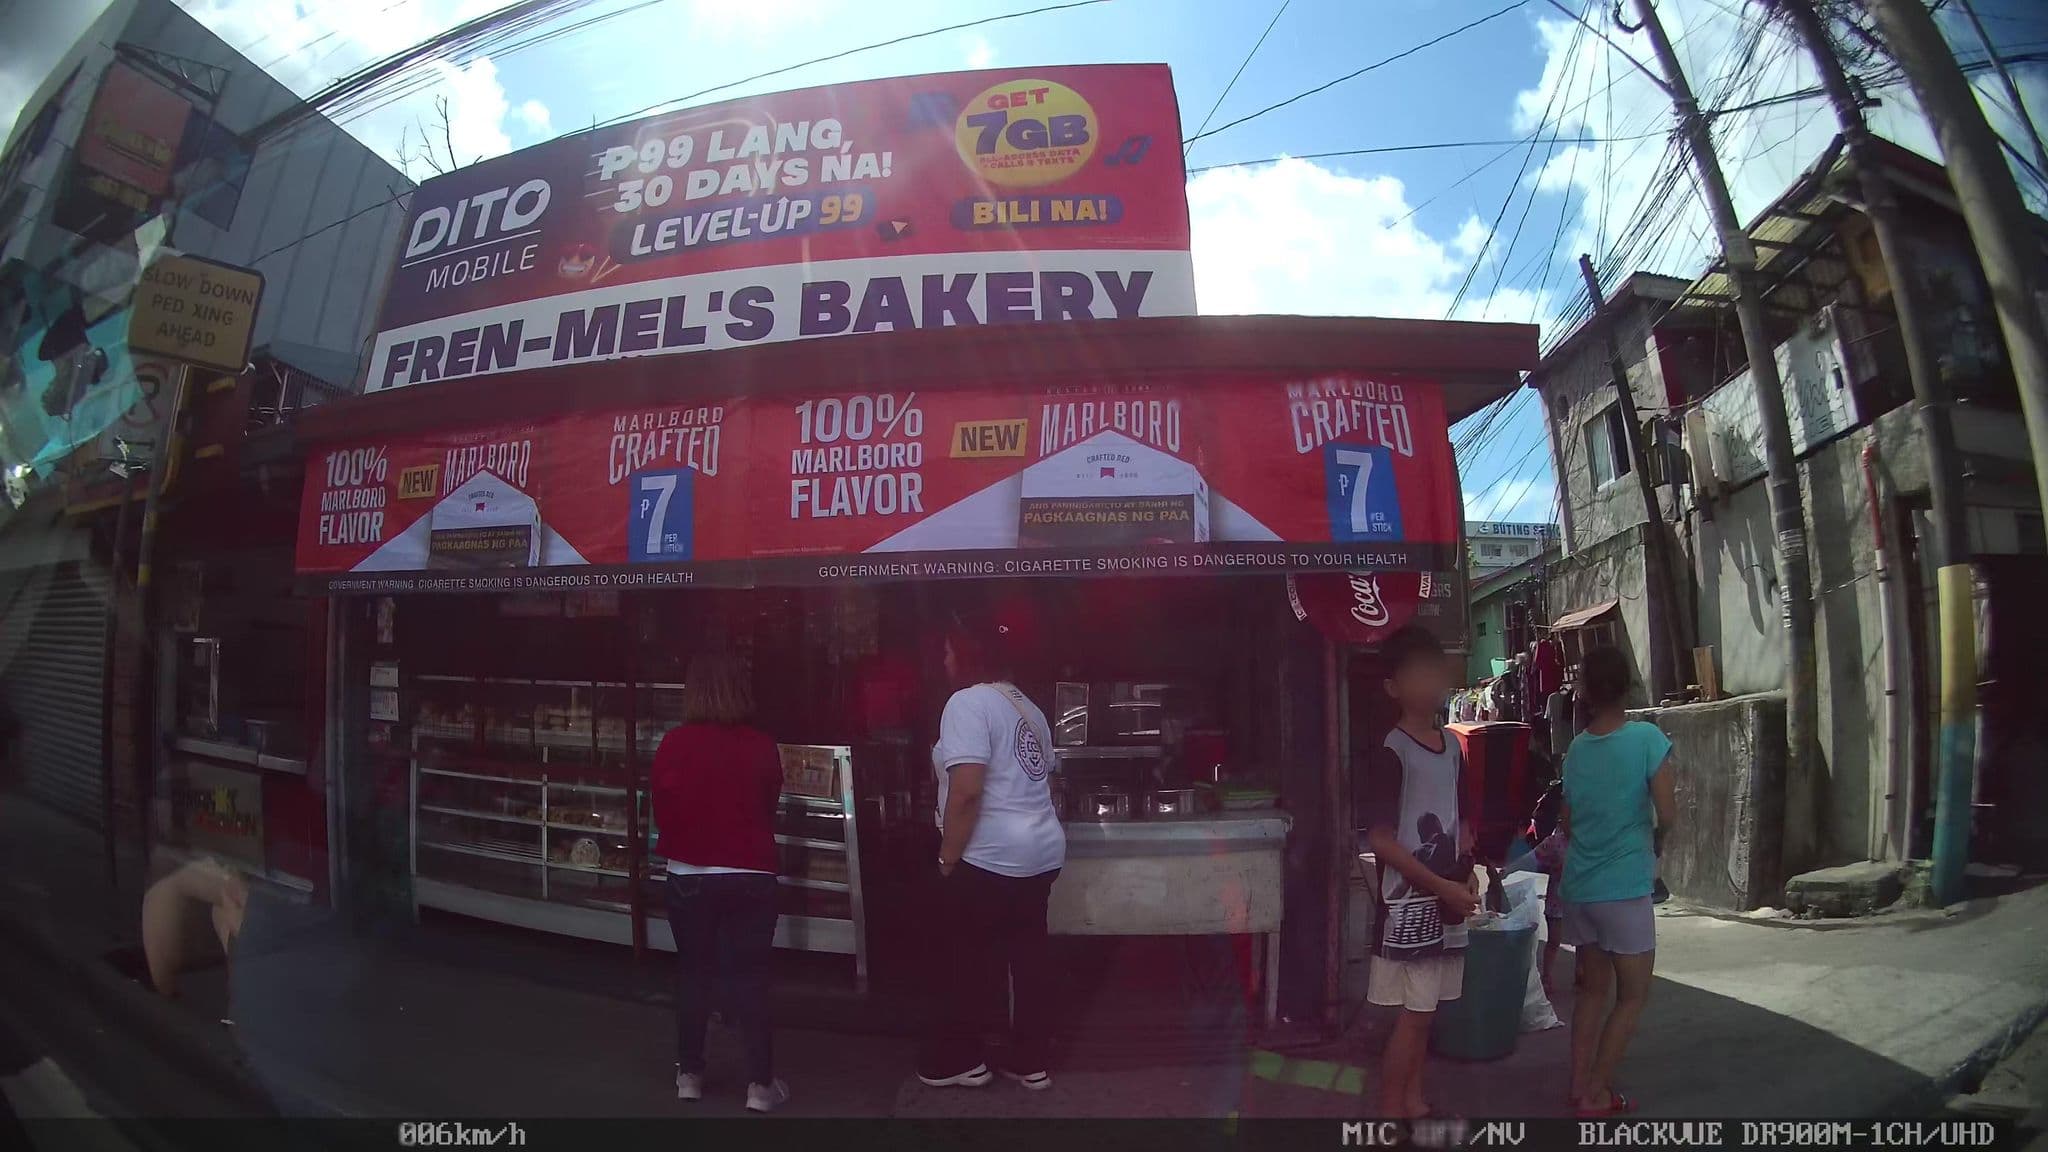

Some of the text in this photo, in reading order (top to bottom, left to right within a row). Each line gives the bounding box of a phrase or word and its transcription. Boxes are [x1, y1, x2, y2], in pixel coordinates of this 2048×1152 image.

[987, 87, 1049, 110] GET
[707, 119, 854, 163] LANG,
[967, 111, 1090, 155] 7GB
[614, 152, 892, 213] 30 DAYS NA!
[405, 179, 552, 259] DITO
[631, 194, 864, 256] LEVEL-UP 99
[973, 199, 1107, 225] BILI NA!
[143, 267, 254, 306] SLOW DOWN
[426, 244, 539, 293] MOBILE
[152, 294, 234, 326] PED XING
[381, 270, 1154, 389] FREN-MEL'S BAKERY
[156, 321, 216, 346] AHEAD
[613, 406, 724, 432] MARLBORO
[795, 391, 923, 443] 100%
[1039, 399, 1182, 457] MARLBORO
[1290, 398, 1414, 457] CRAFTED
[326, 444, 388, 488] 100%
[443, 440, 531, 496] MARLBORO
[609, 424, 721, 485] CRAFTED
[791, 441, 923, 475] MARLBORO
[320, 486, 386, 512] MARLBORO
[790, 472, 924, 519] FLAVOR
[1023, 510, 1190, 524] PAGKAAGNAS NG PAA
[319, 511, 385, 546] FLAVOR
[1493, 524, 1530, 536] BUTING
[418, 578, 466, 590] CIGARETTE
[468, 577, 511, 589] SMOKING
[513, 576, 523, 587] IS
[526, 575, 591, 587] DANGEROUS
[594, 574, 609, 586] TO
[612, 573, 644, 585] YOUR
[648, 572, 693, 584] HEALTH
[818, 553, 1407, 578] GOVERNMENT WARNING: CIGARETTE SMOKING IS DANGEROUS TO YOUR HEALTH
